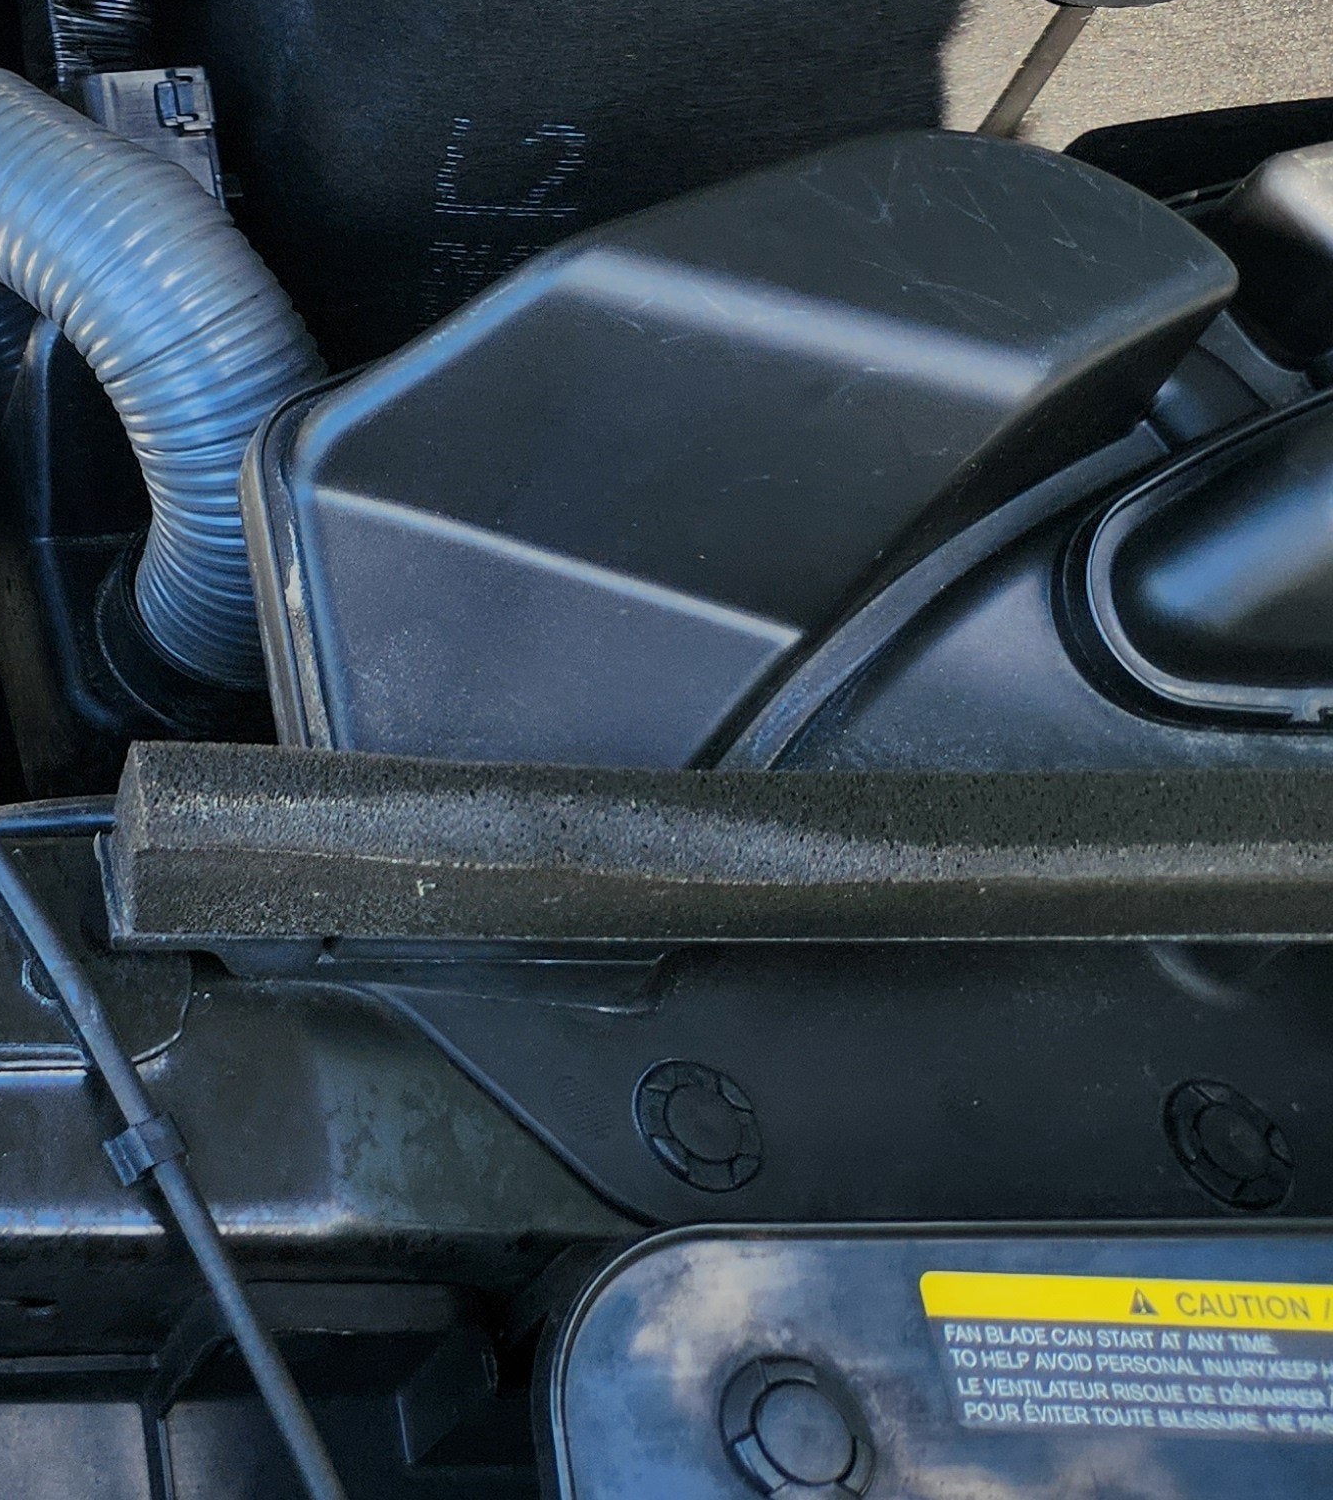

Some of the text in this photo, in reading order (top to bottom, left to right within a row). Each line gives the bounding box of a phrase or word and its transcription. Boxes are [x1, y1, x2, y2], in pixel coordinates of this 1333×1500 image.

[1176, 1291, 1311, 1320] CAUTION
[944, 1324, 982, 1343] FAN
[984, 1325, 1048, 1345] BLADE
[1051, 1327, 1093, 1346] CAN
[1096, 1329, 1153, 1349] START
[1160, 1331, 1180, 1349] AT
[1187, 1332, 1224, 1351] ANY
[950, 1349, 977, 1368] TO
[981, 1350, 1030, 1369] HELP
[1036, 1352, 1092, 1371] AVOID
[1097, 1353, 1201, 1376] PERSONAL
[957, 1377, 981, 1395] LE
[984, 1378, 1110, 1400] VENTILATEUR
[1111, 1382, 1185, 1403] RISQUE
[1188, 1385, 1216, 1404] DE
[964, 1402, 1021, 1422] POUR
[1023, 1398, 1090, 1424] ÉVITER
[1090, 1405, 1156, 1428] TOUTE
